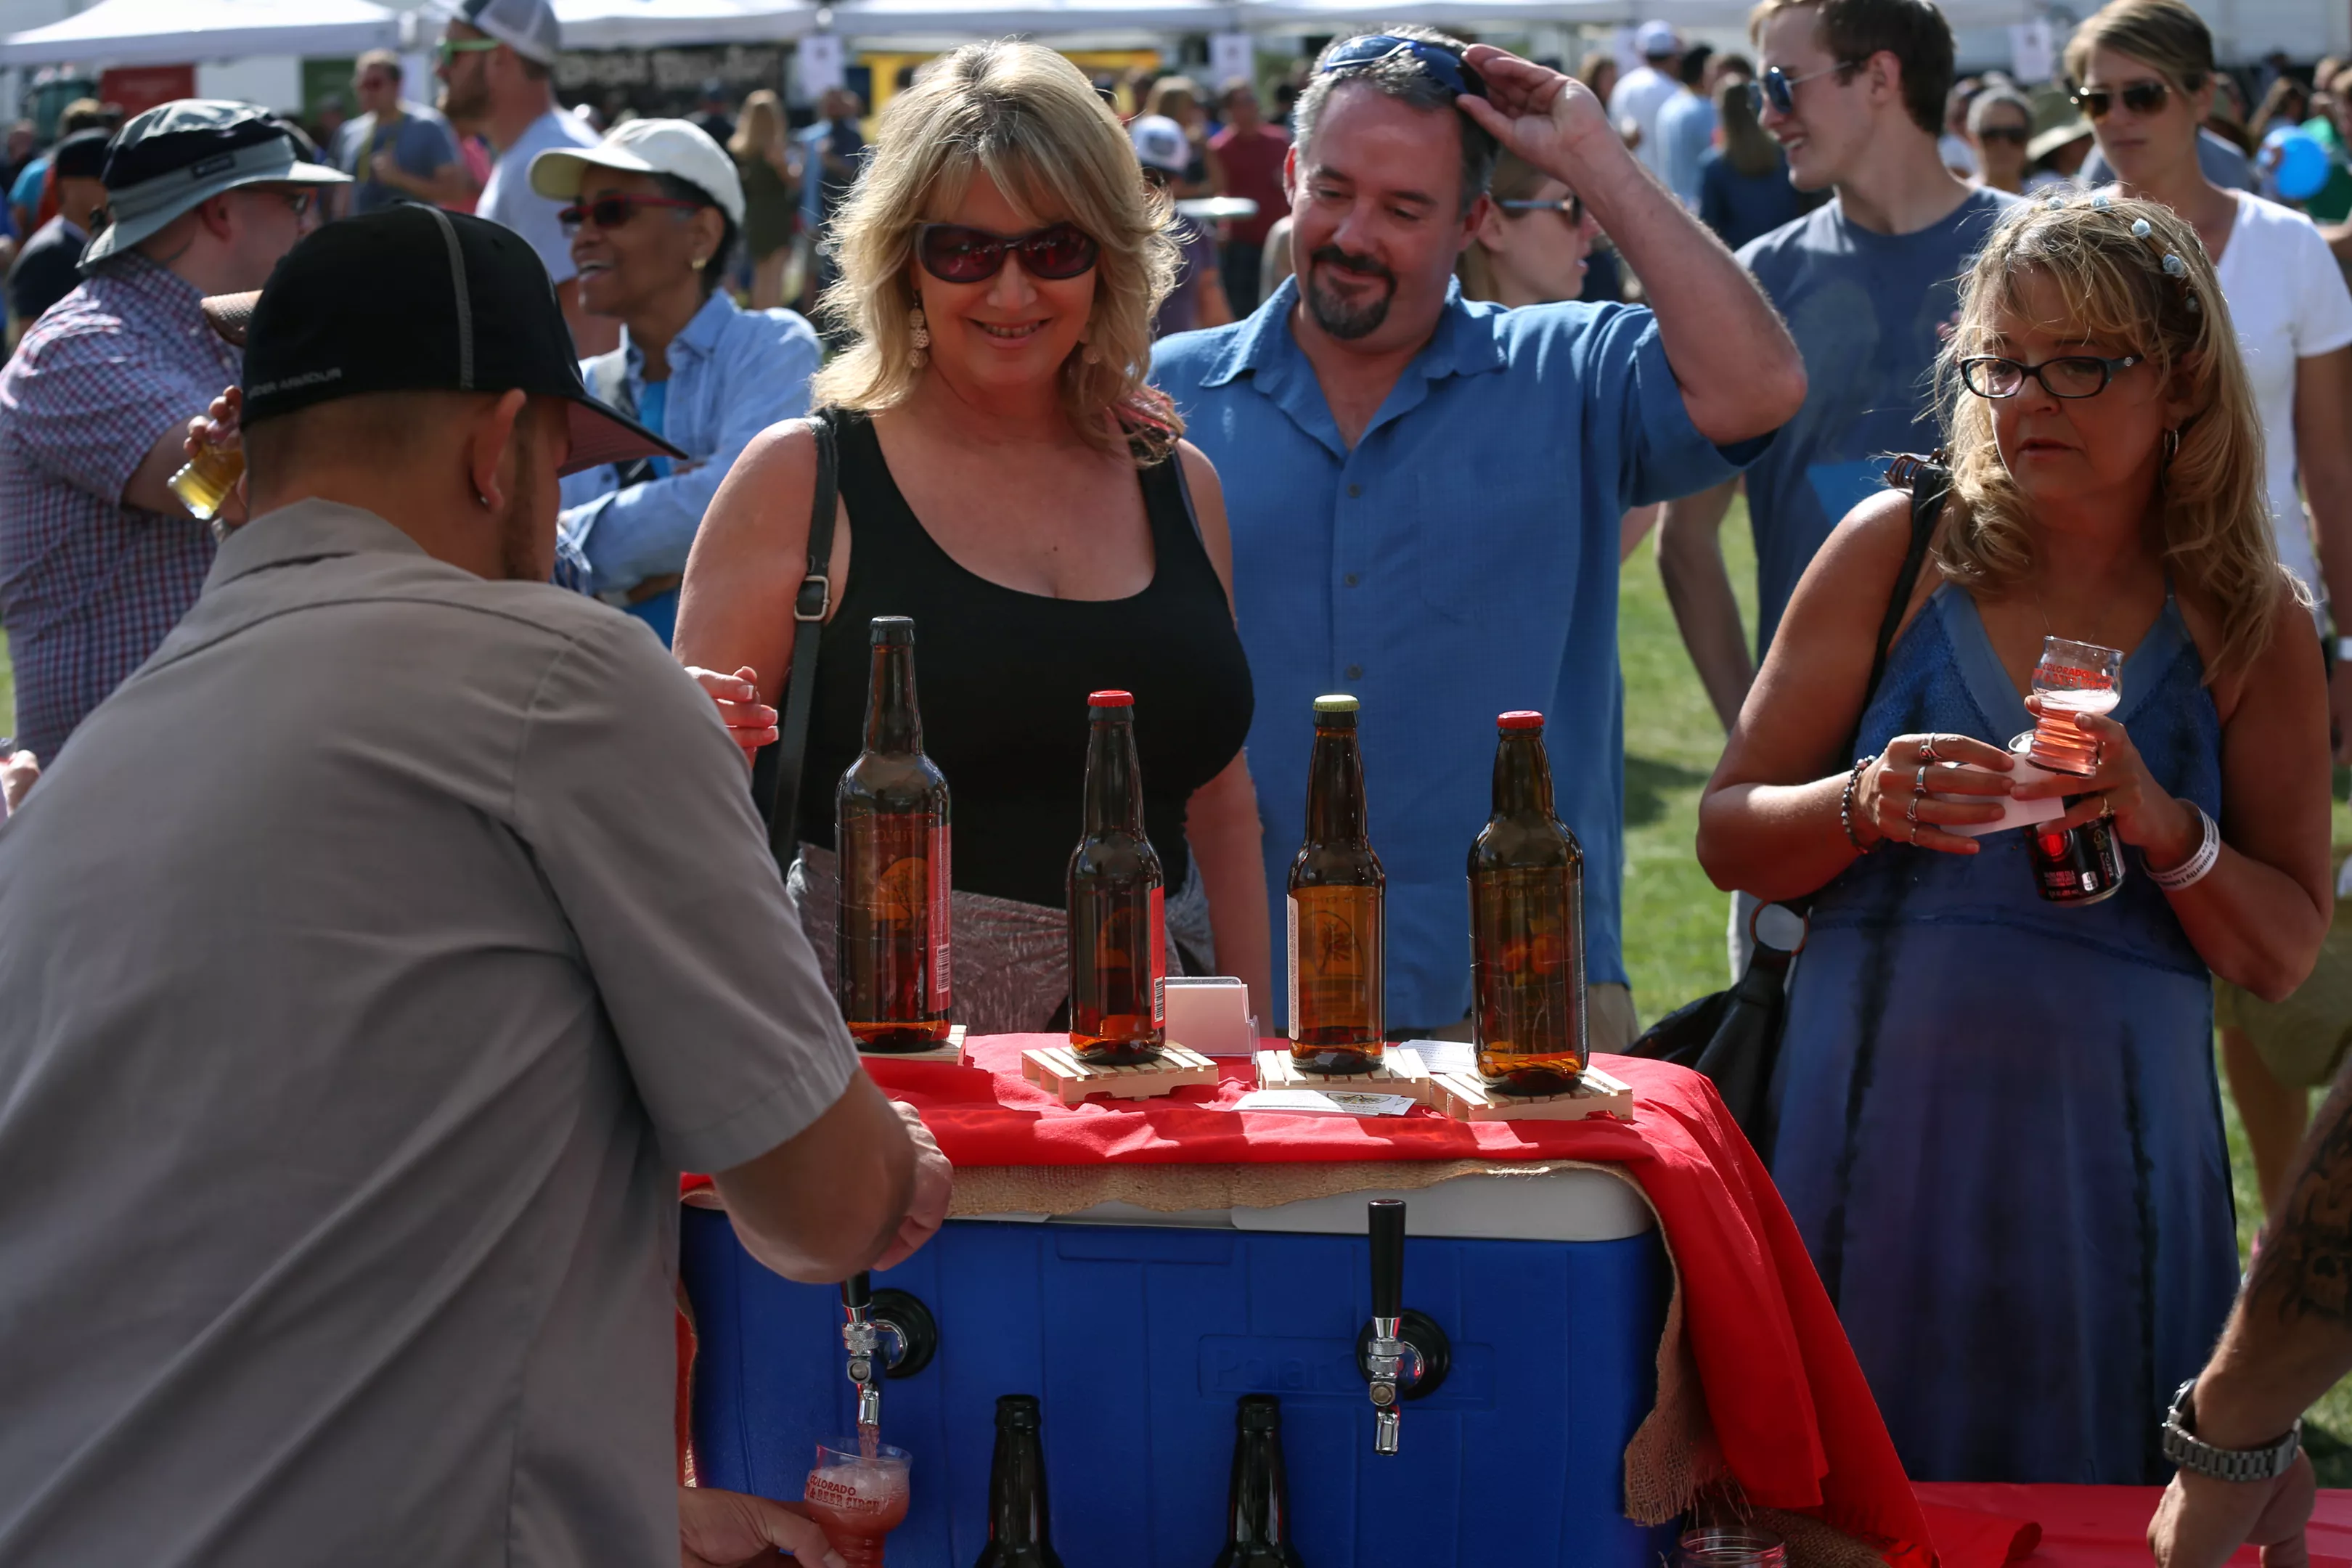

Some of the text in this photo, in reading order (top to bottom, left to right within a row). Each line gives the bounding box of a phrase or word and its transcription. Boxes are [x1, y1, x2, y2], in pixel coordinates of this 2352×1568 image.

[2043, 663, 2090, 679] COLORADO
[809, 1474, 857, 1496] COLORADO
[817, 1489, 843, 1508] BEER
